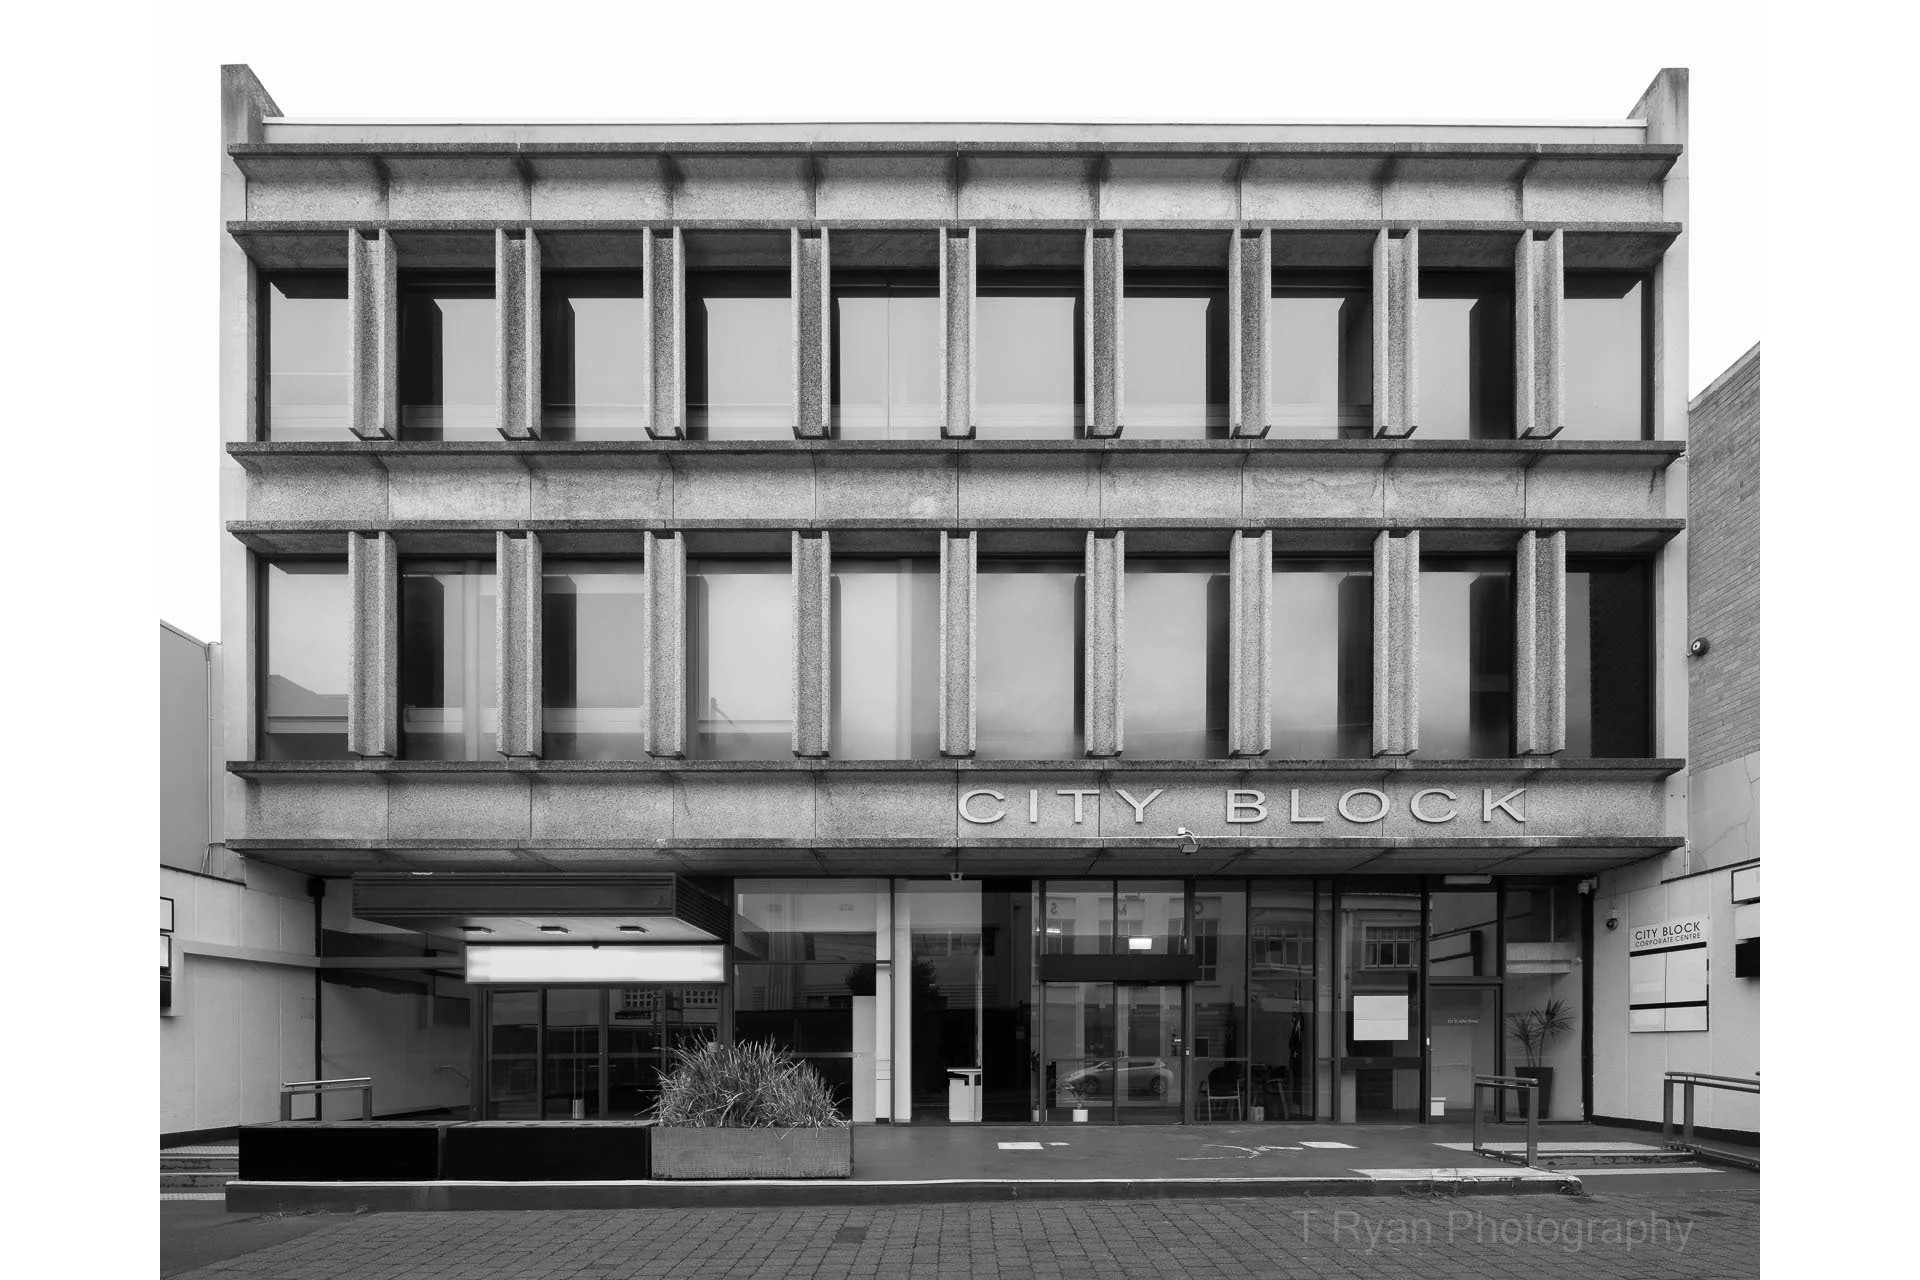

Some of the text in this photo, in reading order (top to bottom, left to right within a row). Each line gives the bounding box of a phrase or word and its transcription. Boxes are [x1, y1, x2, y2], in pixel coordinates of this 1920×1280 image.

[957, 788, 1527, 824] CITY BLOCK
[1635, 921, 1701, 941] CITY BLOCK
[1635, 932, 1701, 948] CORPORATE CENTRE
